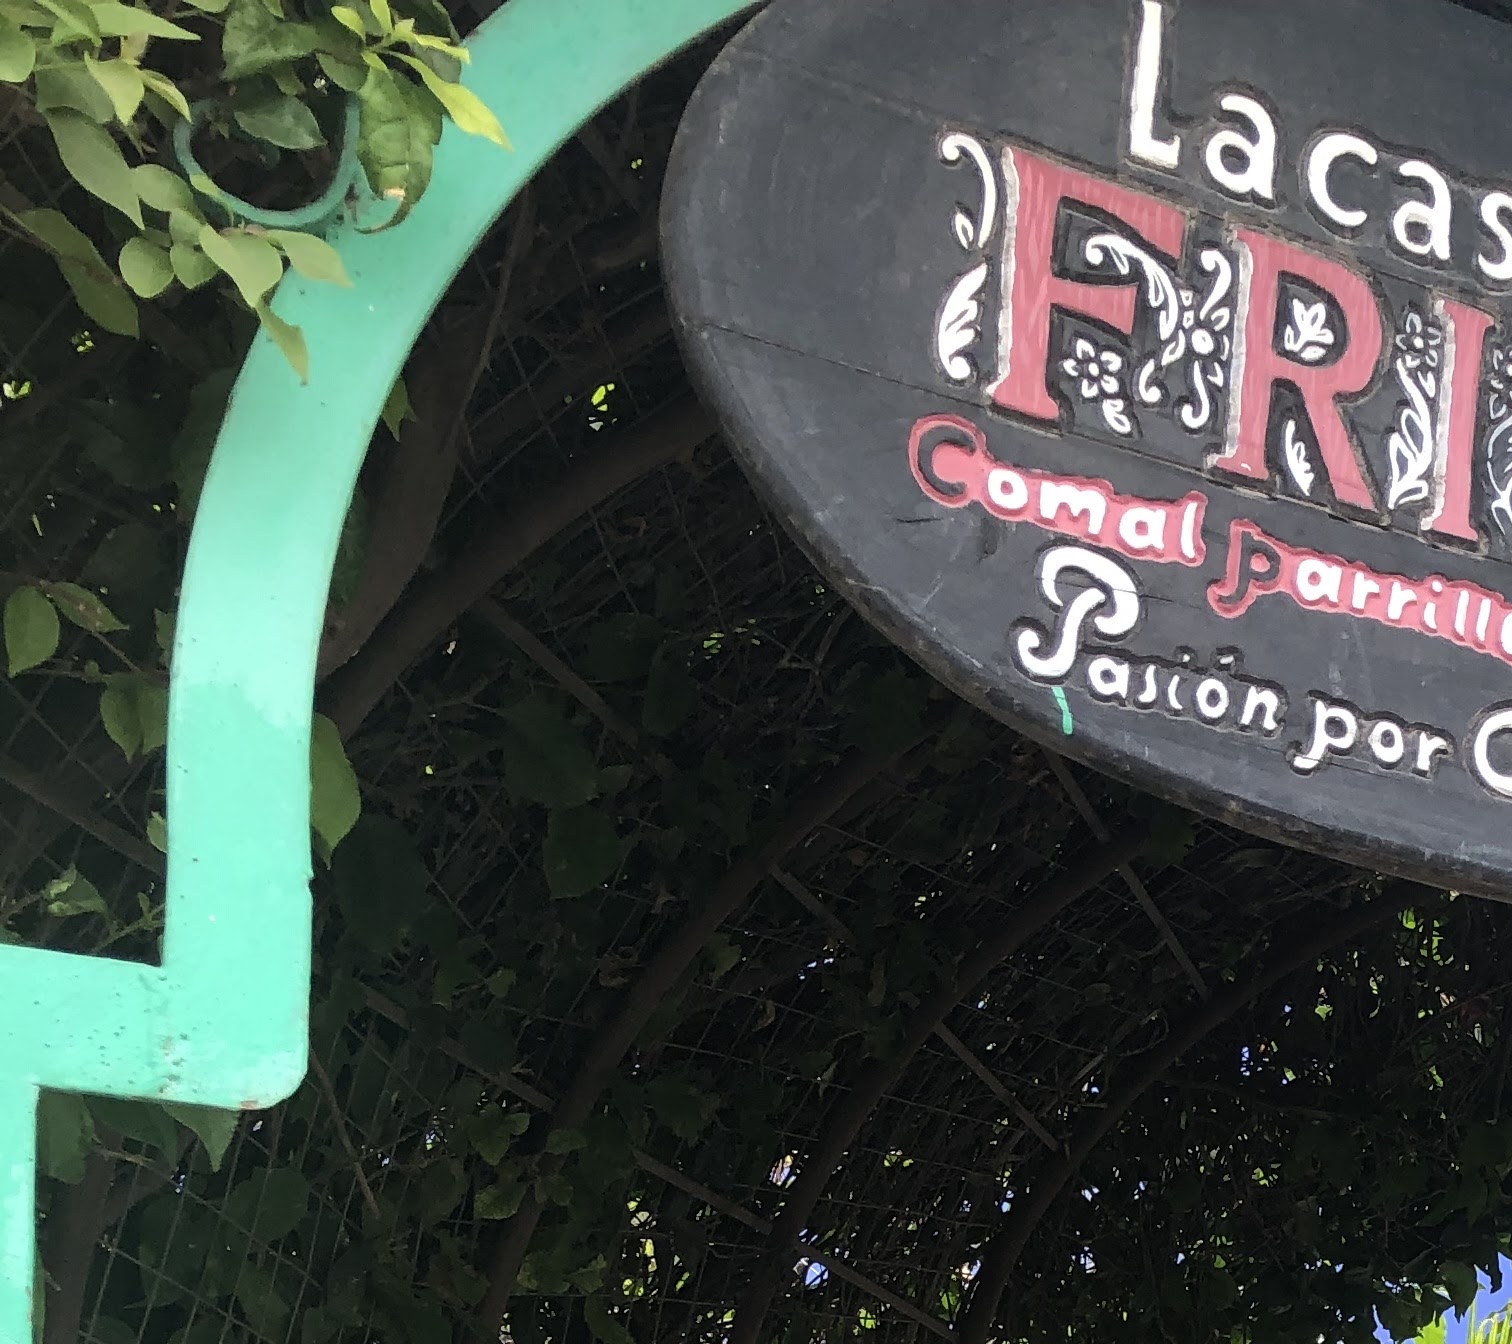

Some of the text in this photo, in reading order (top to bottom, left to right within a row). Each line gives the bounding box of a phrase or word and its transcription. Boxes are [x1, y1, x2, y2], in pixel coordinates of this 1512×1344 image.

[911, 418, 1202, 563] Comal
[1013, 545, 1278, 730] Pasión
[1294, 700, 1449, 773] por
